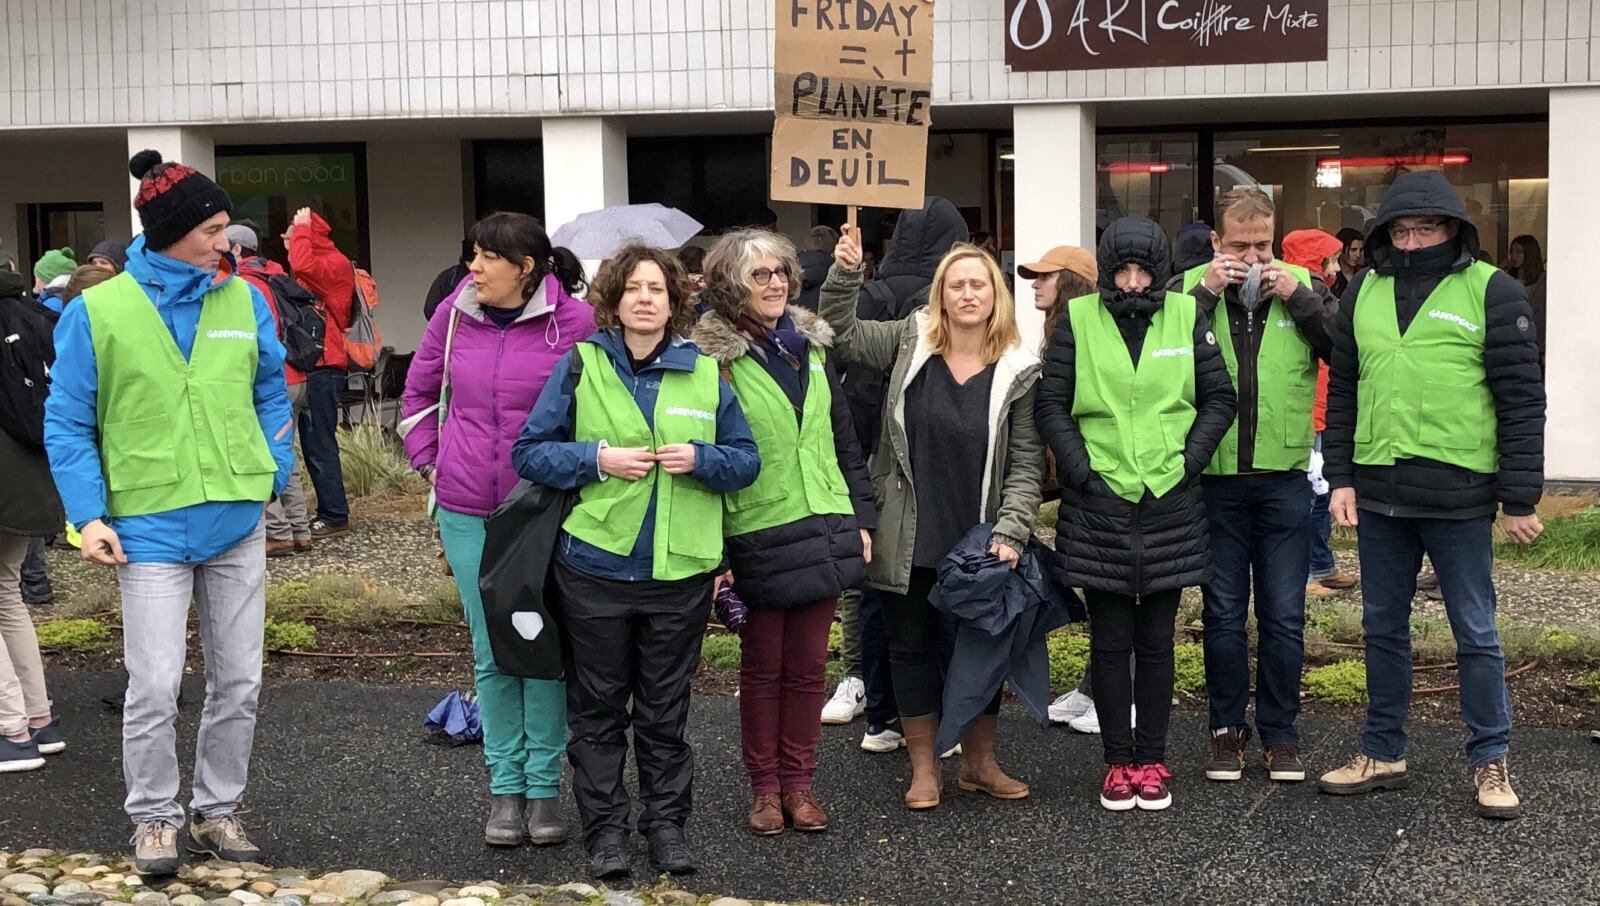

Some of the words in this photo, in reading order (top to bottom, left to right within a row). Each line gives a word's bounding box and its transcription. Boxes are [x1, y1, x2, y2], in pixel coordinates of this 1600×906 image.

[791, 0, 918, 36] FRIDAY
[1263, 3, 1319, 35] Mixte
[792, 66, 931, 126] PLANÈTE
[832, 128, 872, 150] EN
[218, 164, 278, 185] rban
[284, 162, 345, 186] food
[789, 152, 910, 187] DEUIL
